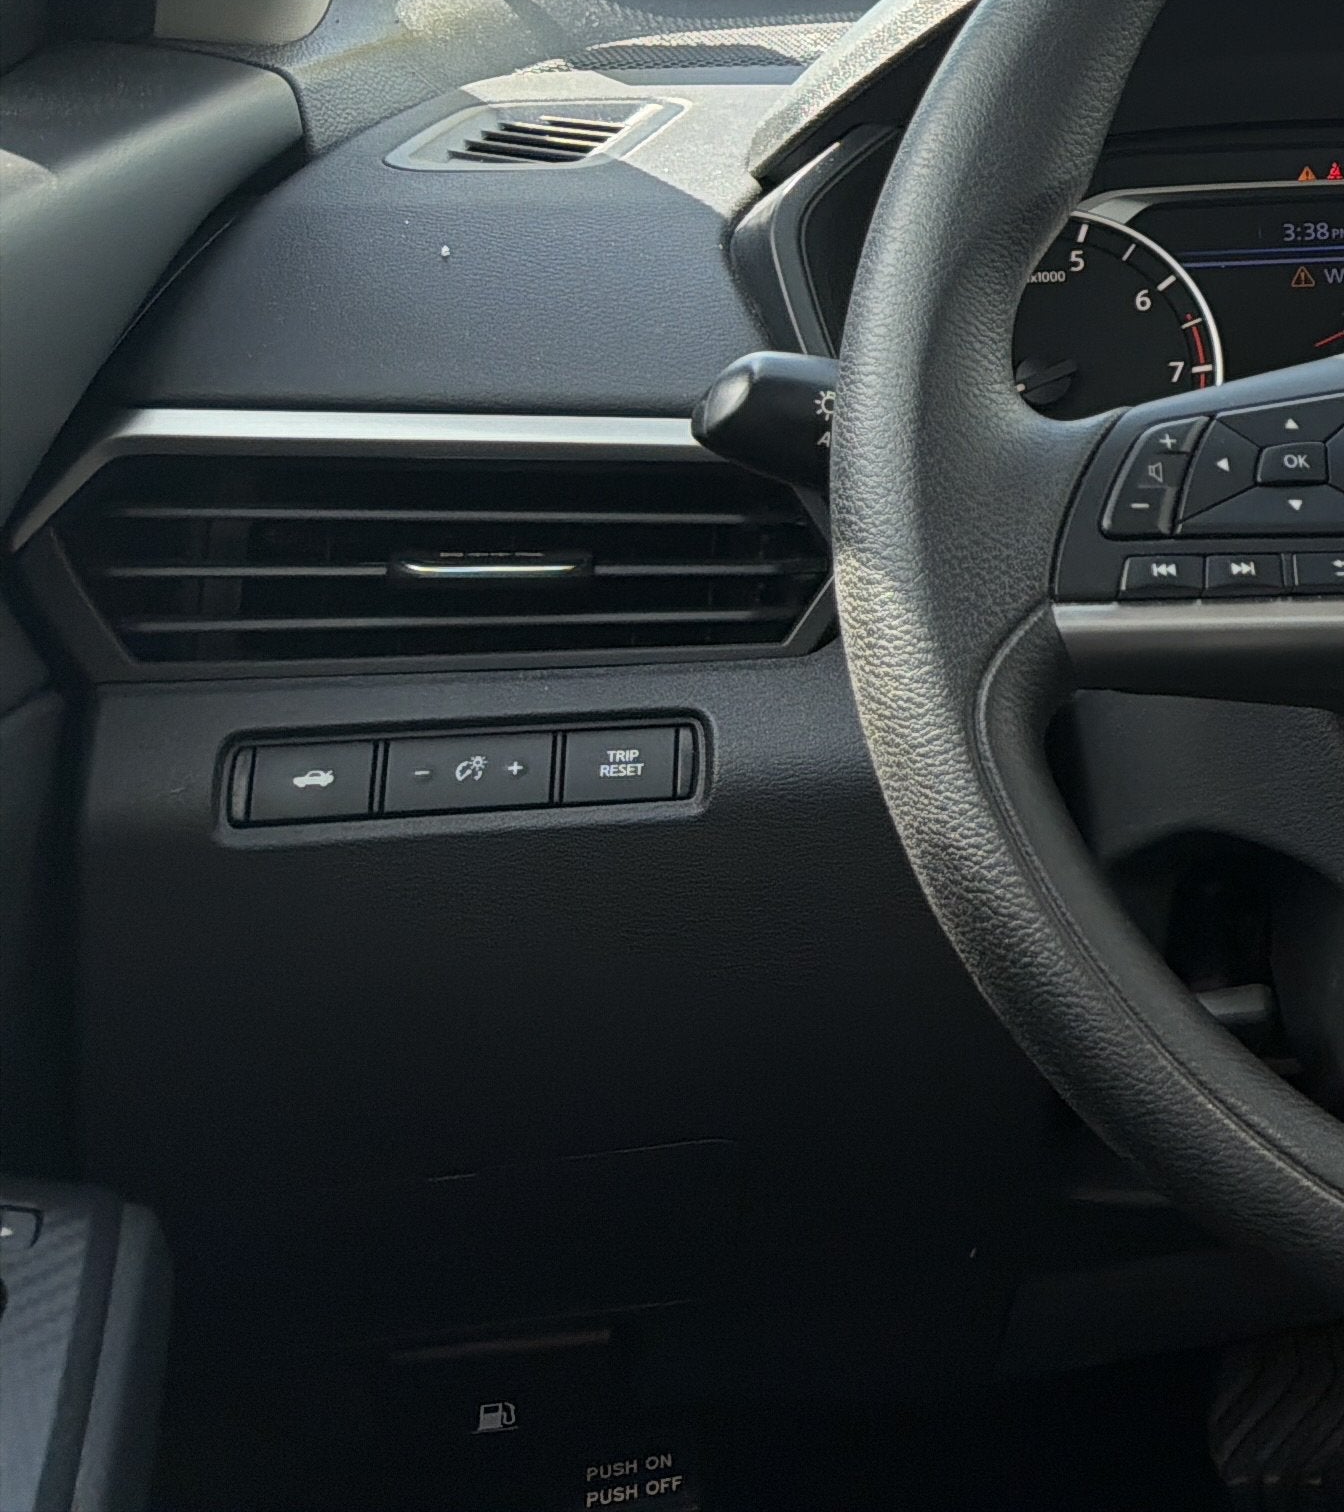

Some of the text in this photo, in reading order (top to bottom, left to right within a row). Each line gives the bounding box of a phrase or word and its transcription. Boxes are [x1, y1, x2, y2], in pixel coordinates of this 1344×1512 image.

[1069, 250, 1085, 272] 5
[1135, 289, 1151, 311] 6
[1168, 361, 1185, 383] 7
[1283, 454, 1311, 470] OK
[606, 749, 640, 763] TRIP
[599, 762, 645, 778] RESET
[586, 1453, 673, 1482] PUSH ON
[585, 1475, 683, 1509] PUSH OFF
